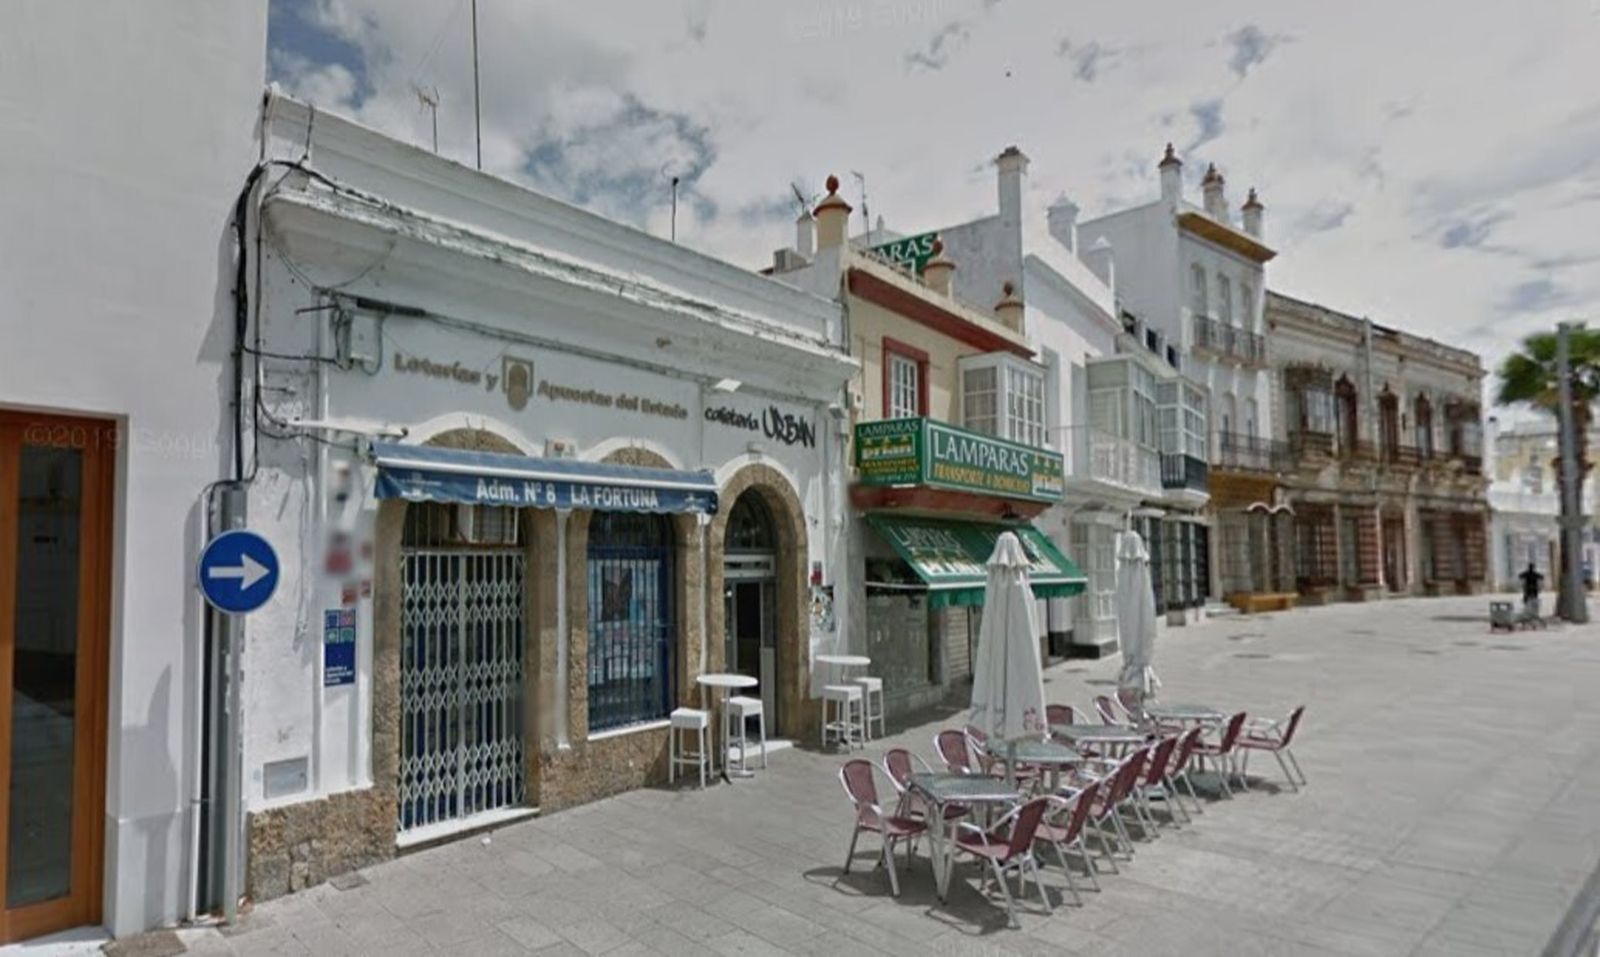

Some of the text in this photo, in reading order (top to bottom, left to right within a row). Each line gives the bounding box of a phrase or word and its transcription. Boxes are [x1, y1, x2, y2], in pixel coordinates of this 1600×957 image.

[394, 352, 499, 393] Loterías y
[537, 379, 688, 420] Apuestas del Estado
[762, 404, 816, 449] URBAN
[858, 418, 919, 438] LAMPARAS
[933, 431, 1029, 476] LAMPARAS
[476, 478, 519, 501] Adm.
[546, 483, 556, 502] 8
[570, 484, 589, 505] LA
[593, 486, 659, 508] FORTUNA
